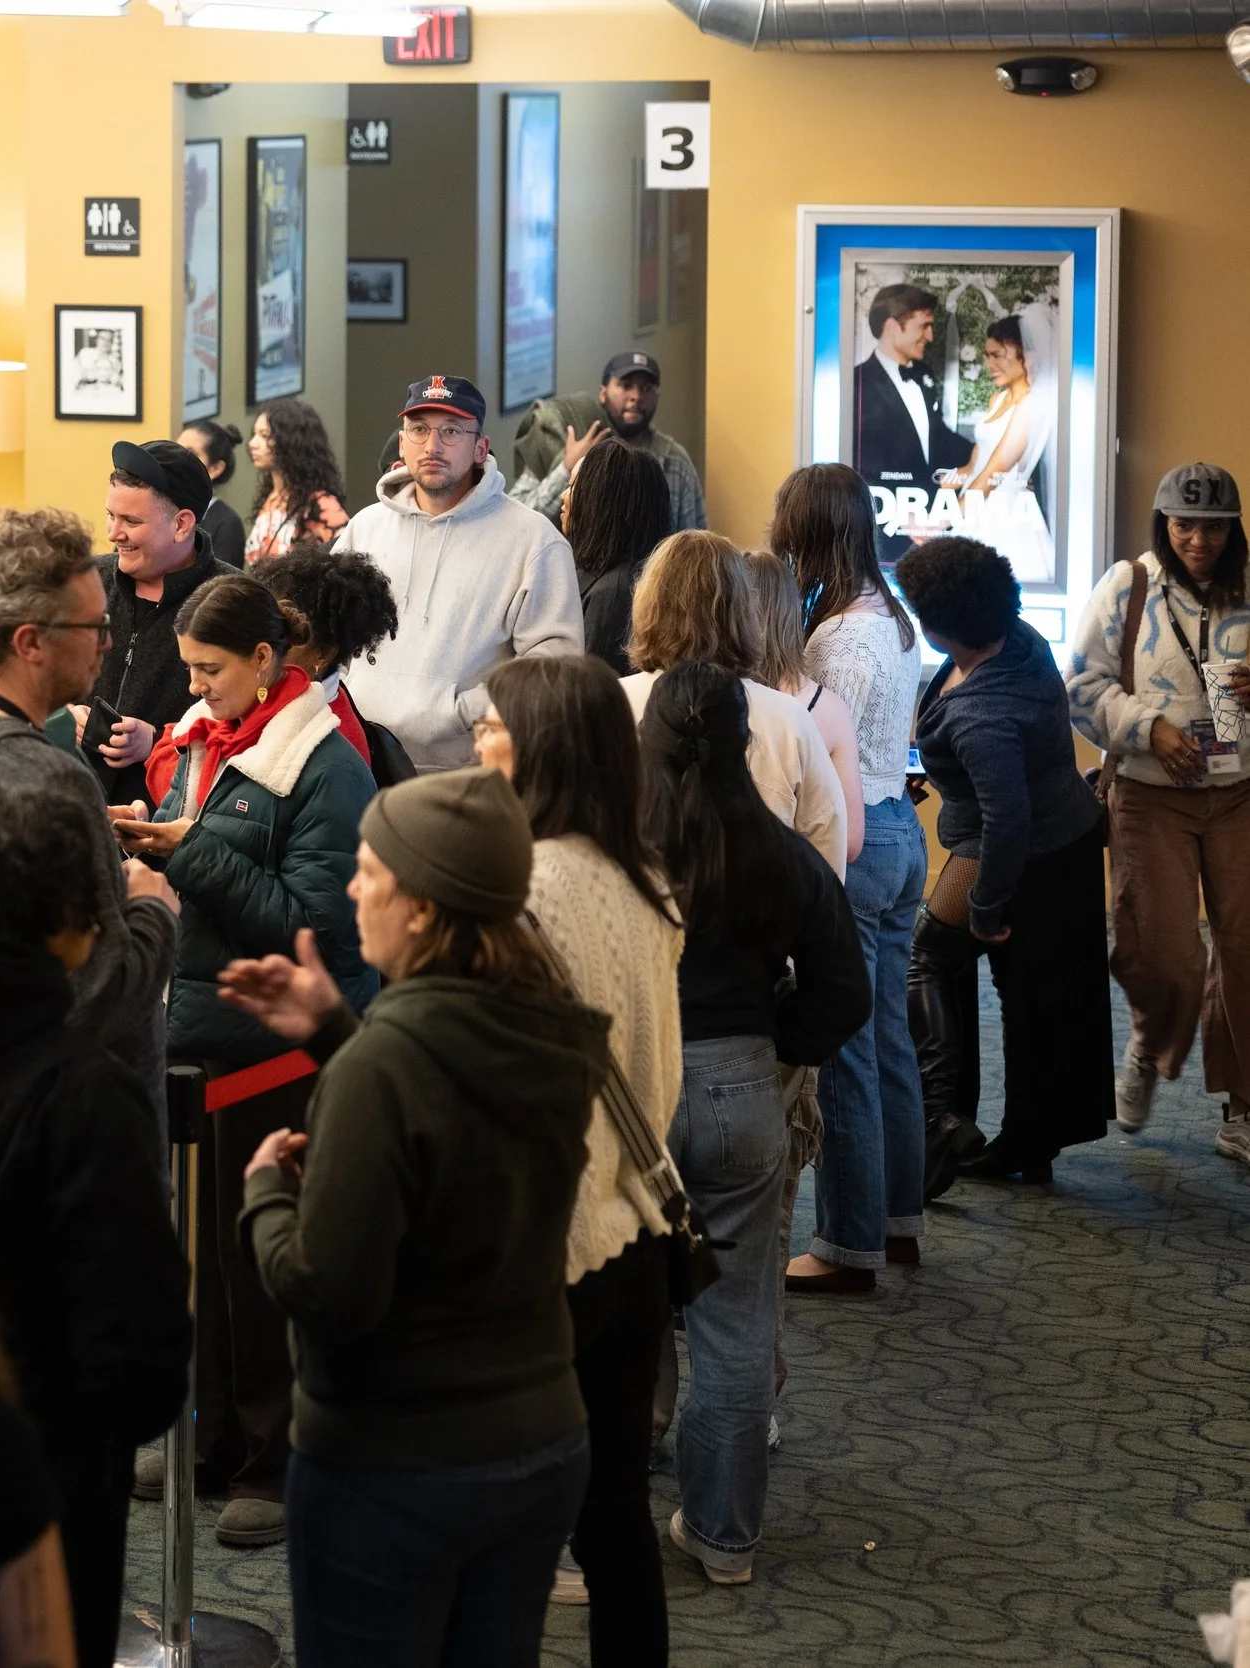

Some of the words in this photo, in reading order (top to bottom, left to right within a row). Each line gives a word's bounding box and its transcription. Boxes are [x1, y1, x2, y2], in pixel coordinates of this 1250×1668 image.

[659, 127, 695, 171] 3
[880, 471, 914, 481] ZENDAYA
[931, 467, 968, 486] The
[868, 486, 1048, 538] DRAMA
